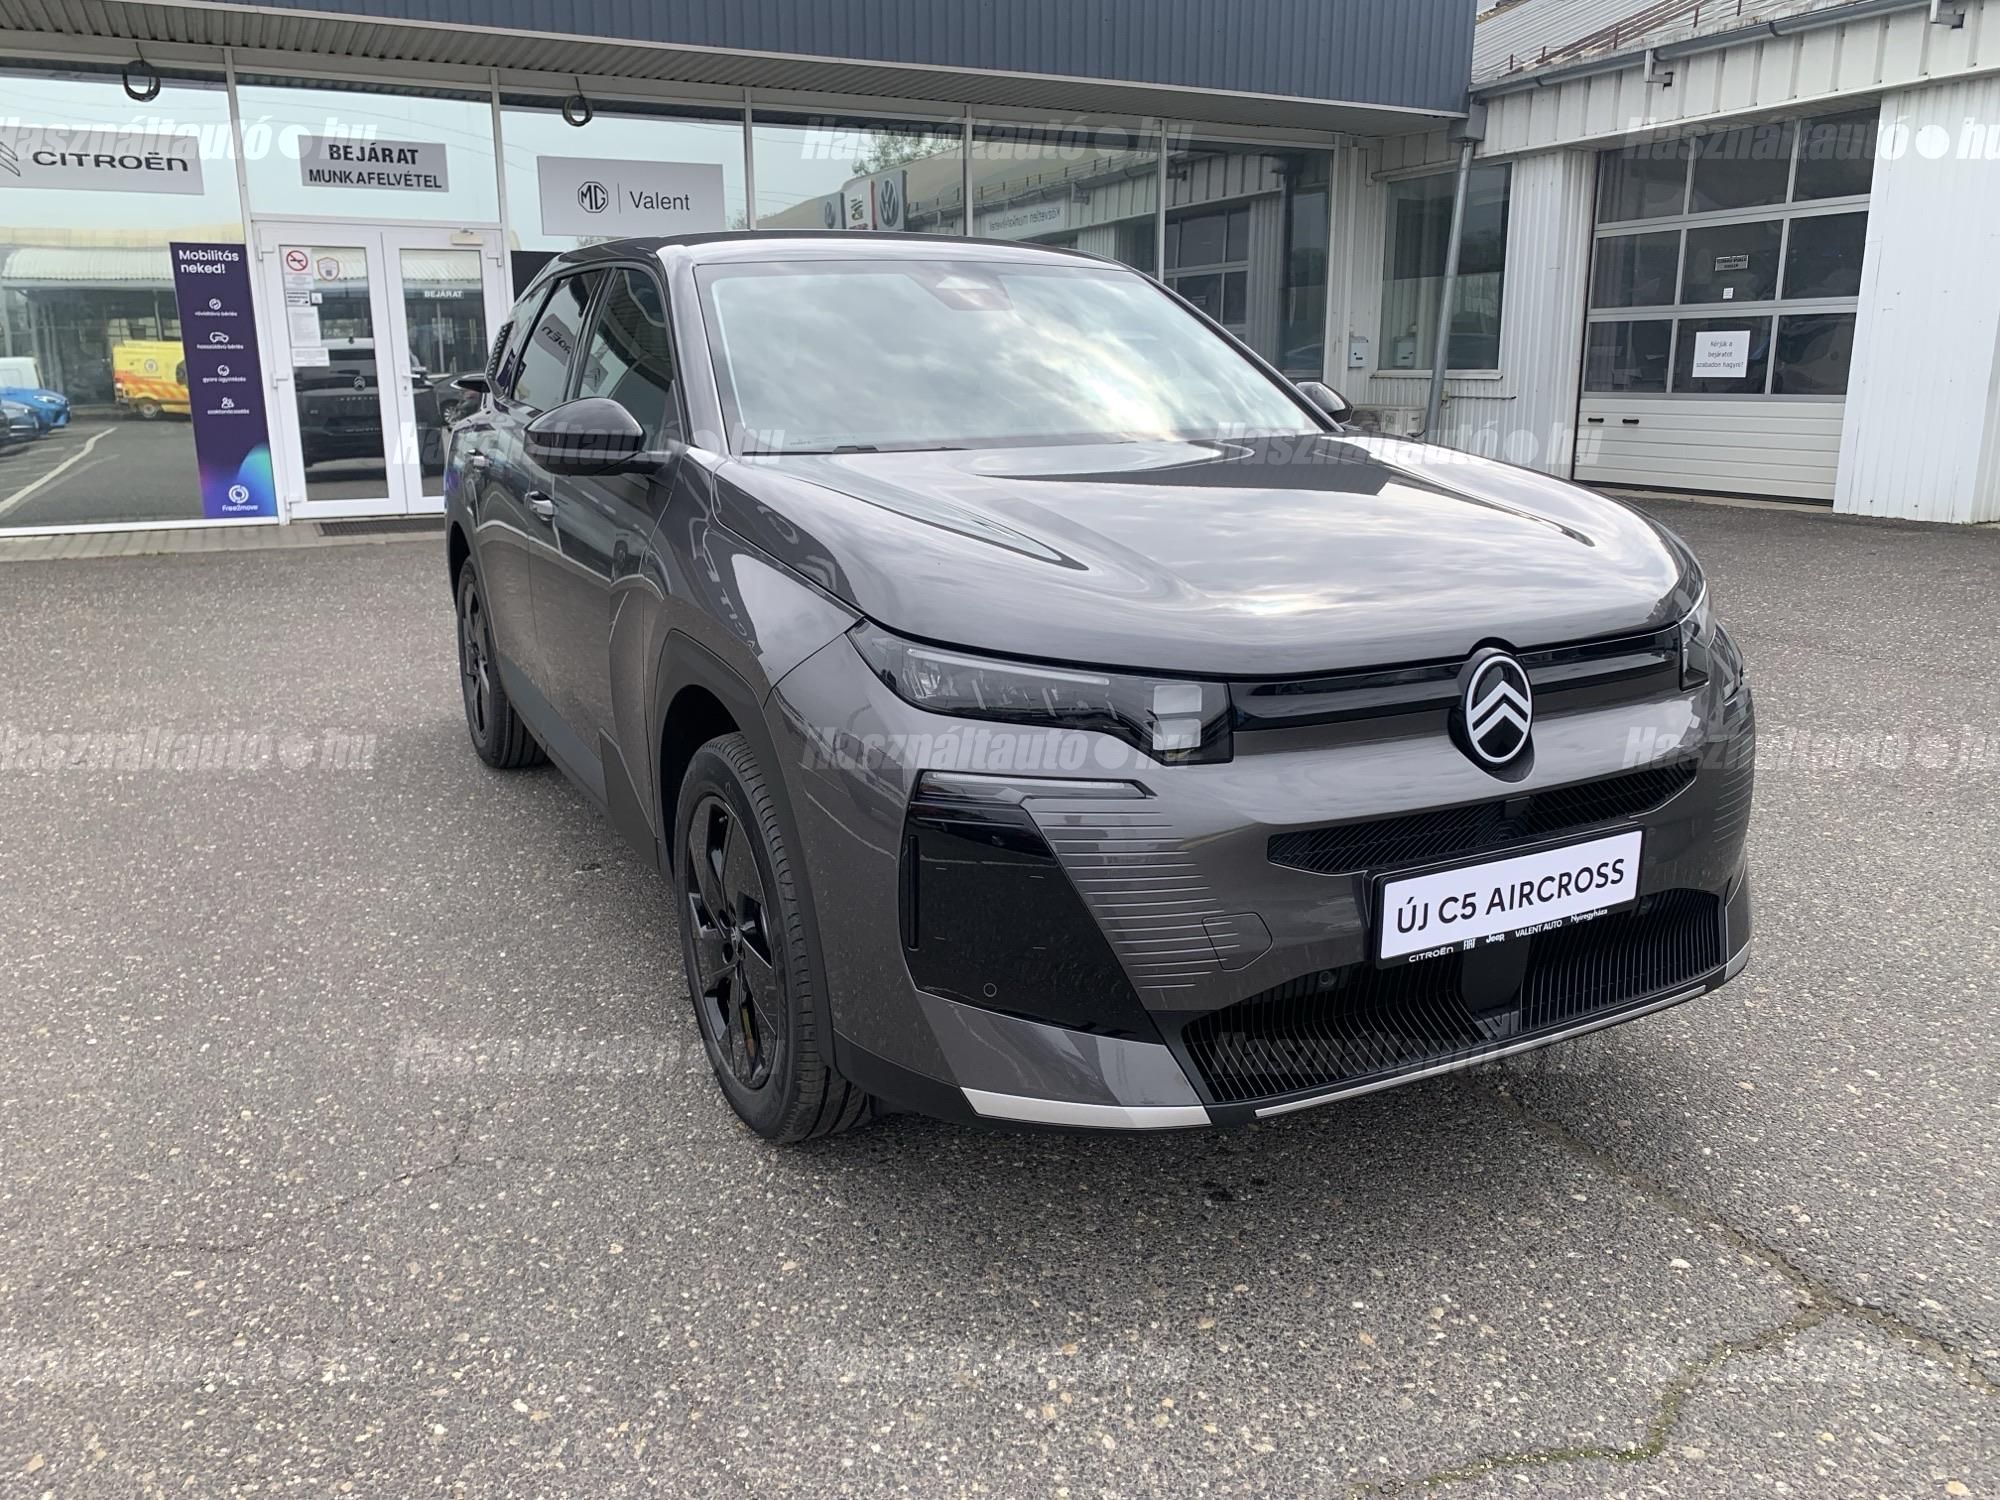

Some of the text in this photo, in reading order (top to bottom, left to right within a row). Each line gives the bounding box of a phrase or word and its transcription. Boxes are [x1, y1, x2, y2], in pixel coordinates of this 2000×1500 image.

[328, 142, 419, 165] BEJÁRAT
[308, 169, 442, 189] MUNKAFELVÉTEL
[579, 183, 690, 212] MG Valent
[178, 249, 240, 261] Mobilitás
[180, 262, 226, 274] neked!
[424, 289, 462, 298] BEJÁRAT
[1396, 858, 1625, 933] ÚJ C5 AIRCROSS
[1463, 937, 1476, 951] FIAT
[1486, 933, 1505, 943] Jeep
[1515, 924, 1543, 938] VALENT
[1543, 920, 1563, 932] AUTO
